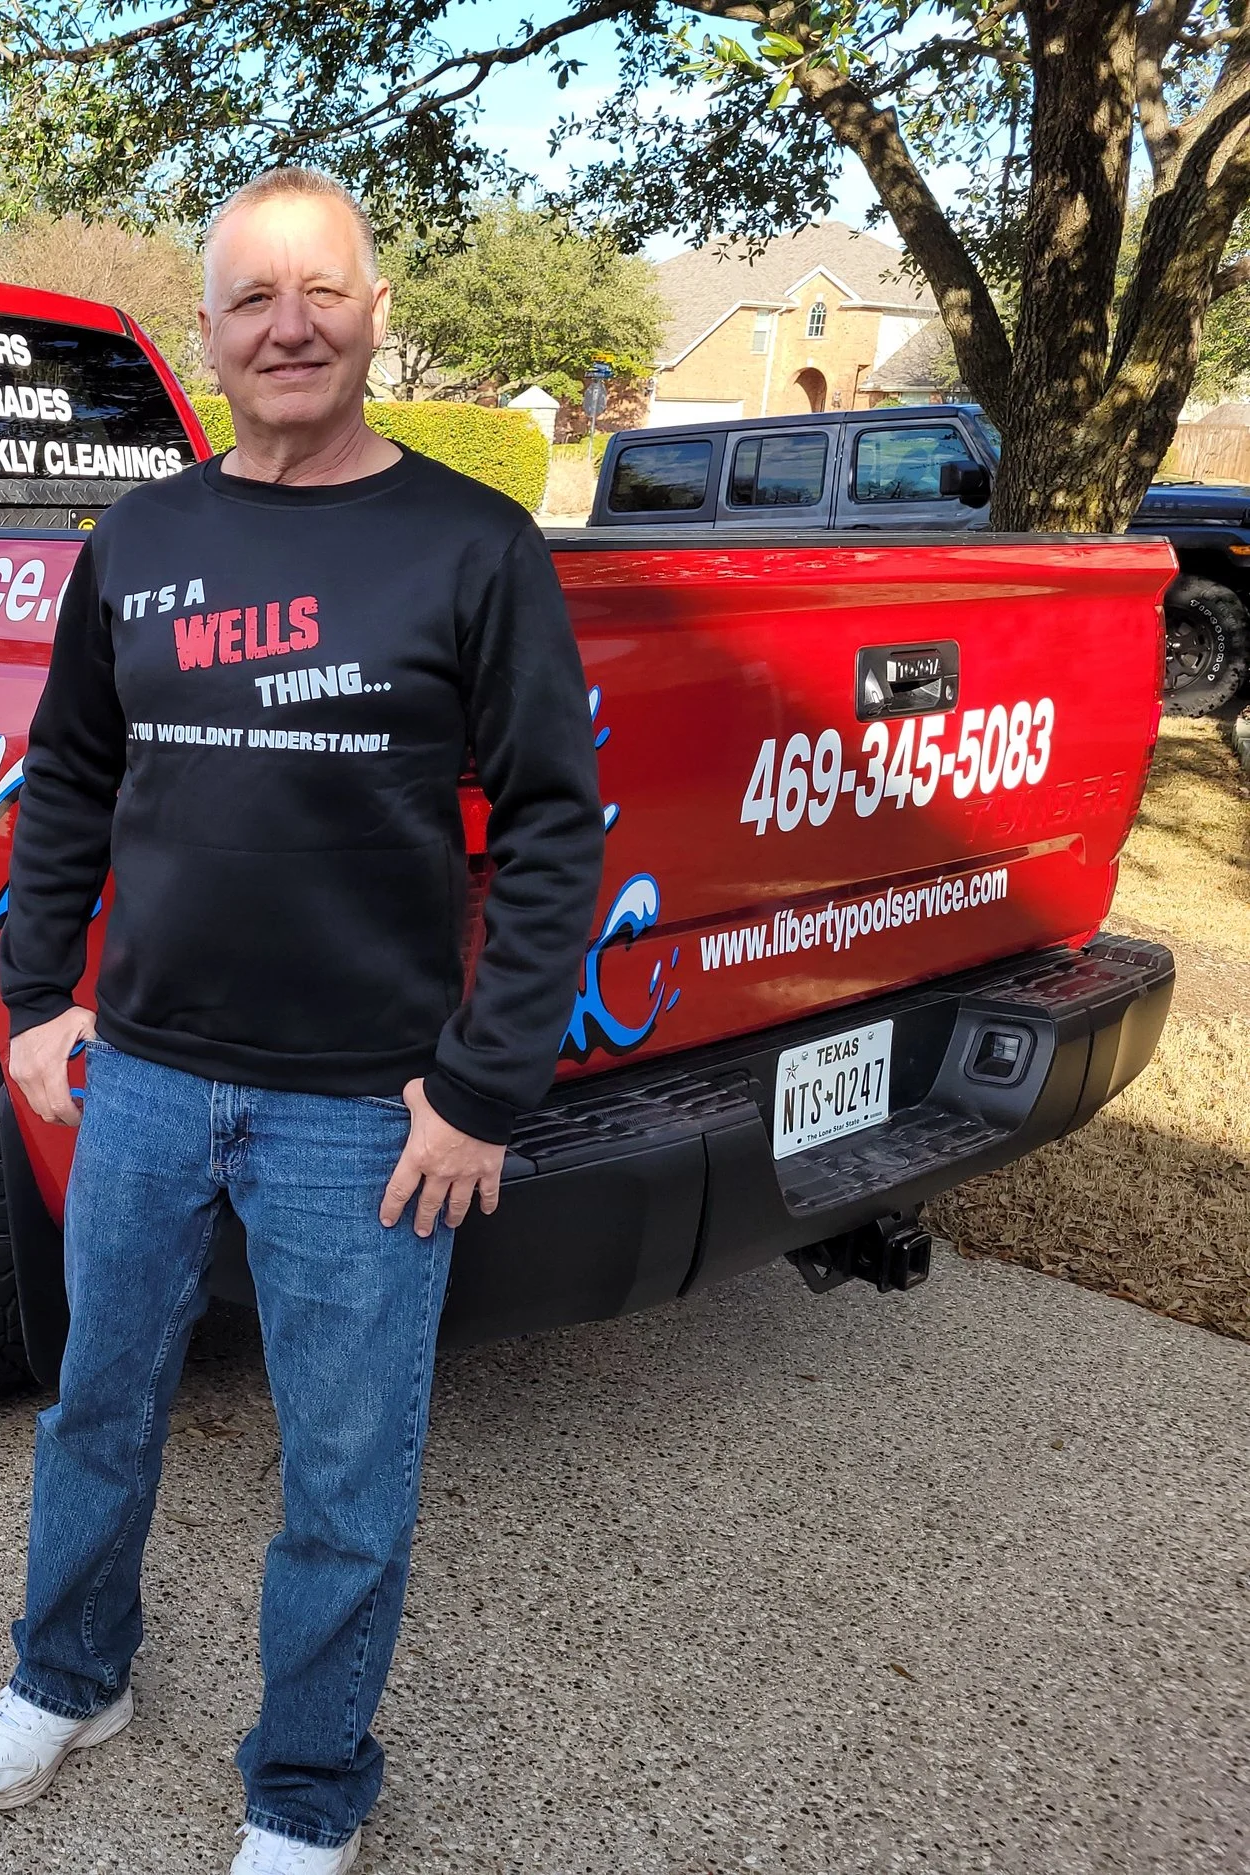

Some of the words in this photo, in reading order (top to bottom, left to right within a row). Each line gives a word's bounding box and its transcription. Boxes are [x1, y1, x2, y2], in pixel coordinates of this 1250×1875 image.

[44, 441, 183, 480] CLEANINGS
[123, 584, 177, 621] IT'S
[183, 578, 206, 607] A
[173, 595, 320, 672] WELLS
[254, 662, 392, 707] THING...
[156, 723, 244, 747] WOULDNT
[247, 729, 390, 753] UNDERSTAND!
[740, 697, 1055, 836] 469-345-5083
[700, 867, 1008, 972] www.libertypoolservice.com
[816, 1037, 860, 1067] TEXAS
[807, 1132, 817, 1141] The
[818, 1129, 831, 1137] Lone
[833, 1124, 844, 1132] Star
[845, 1119, 859, 1127] State
